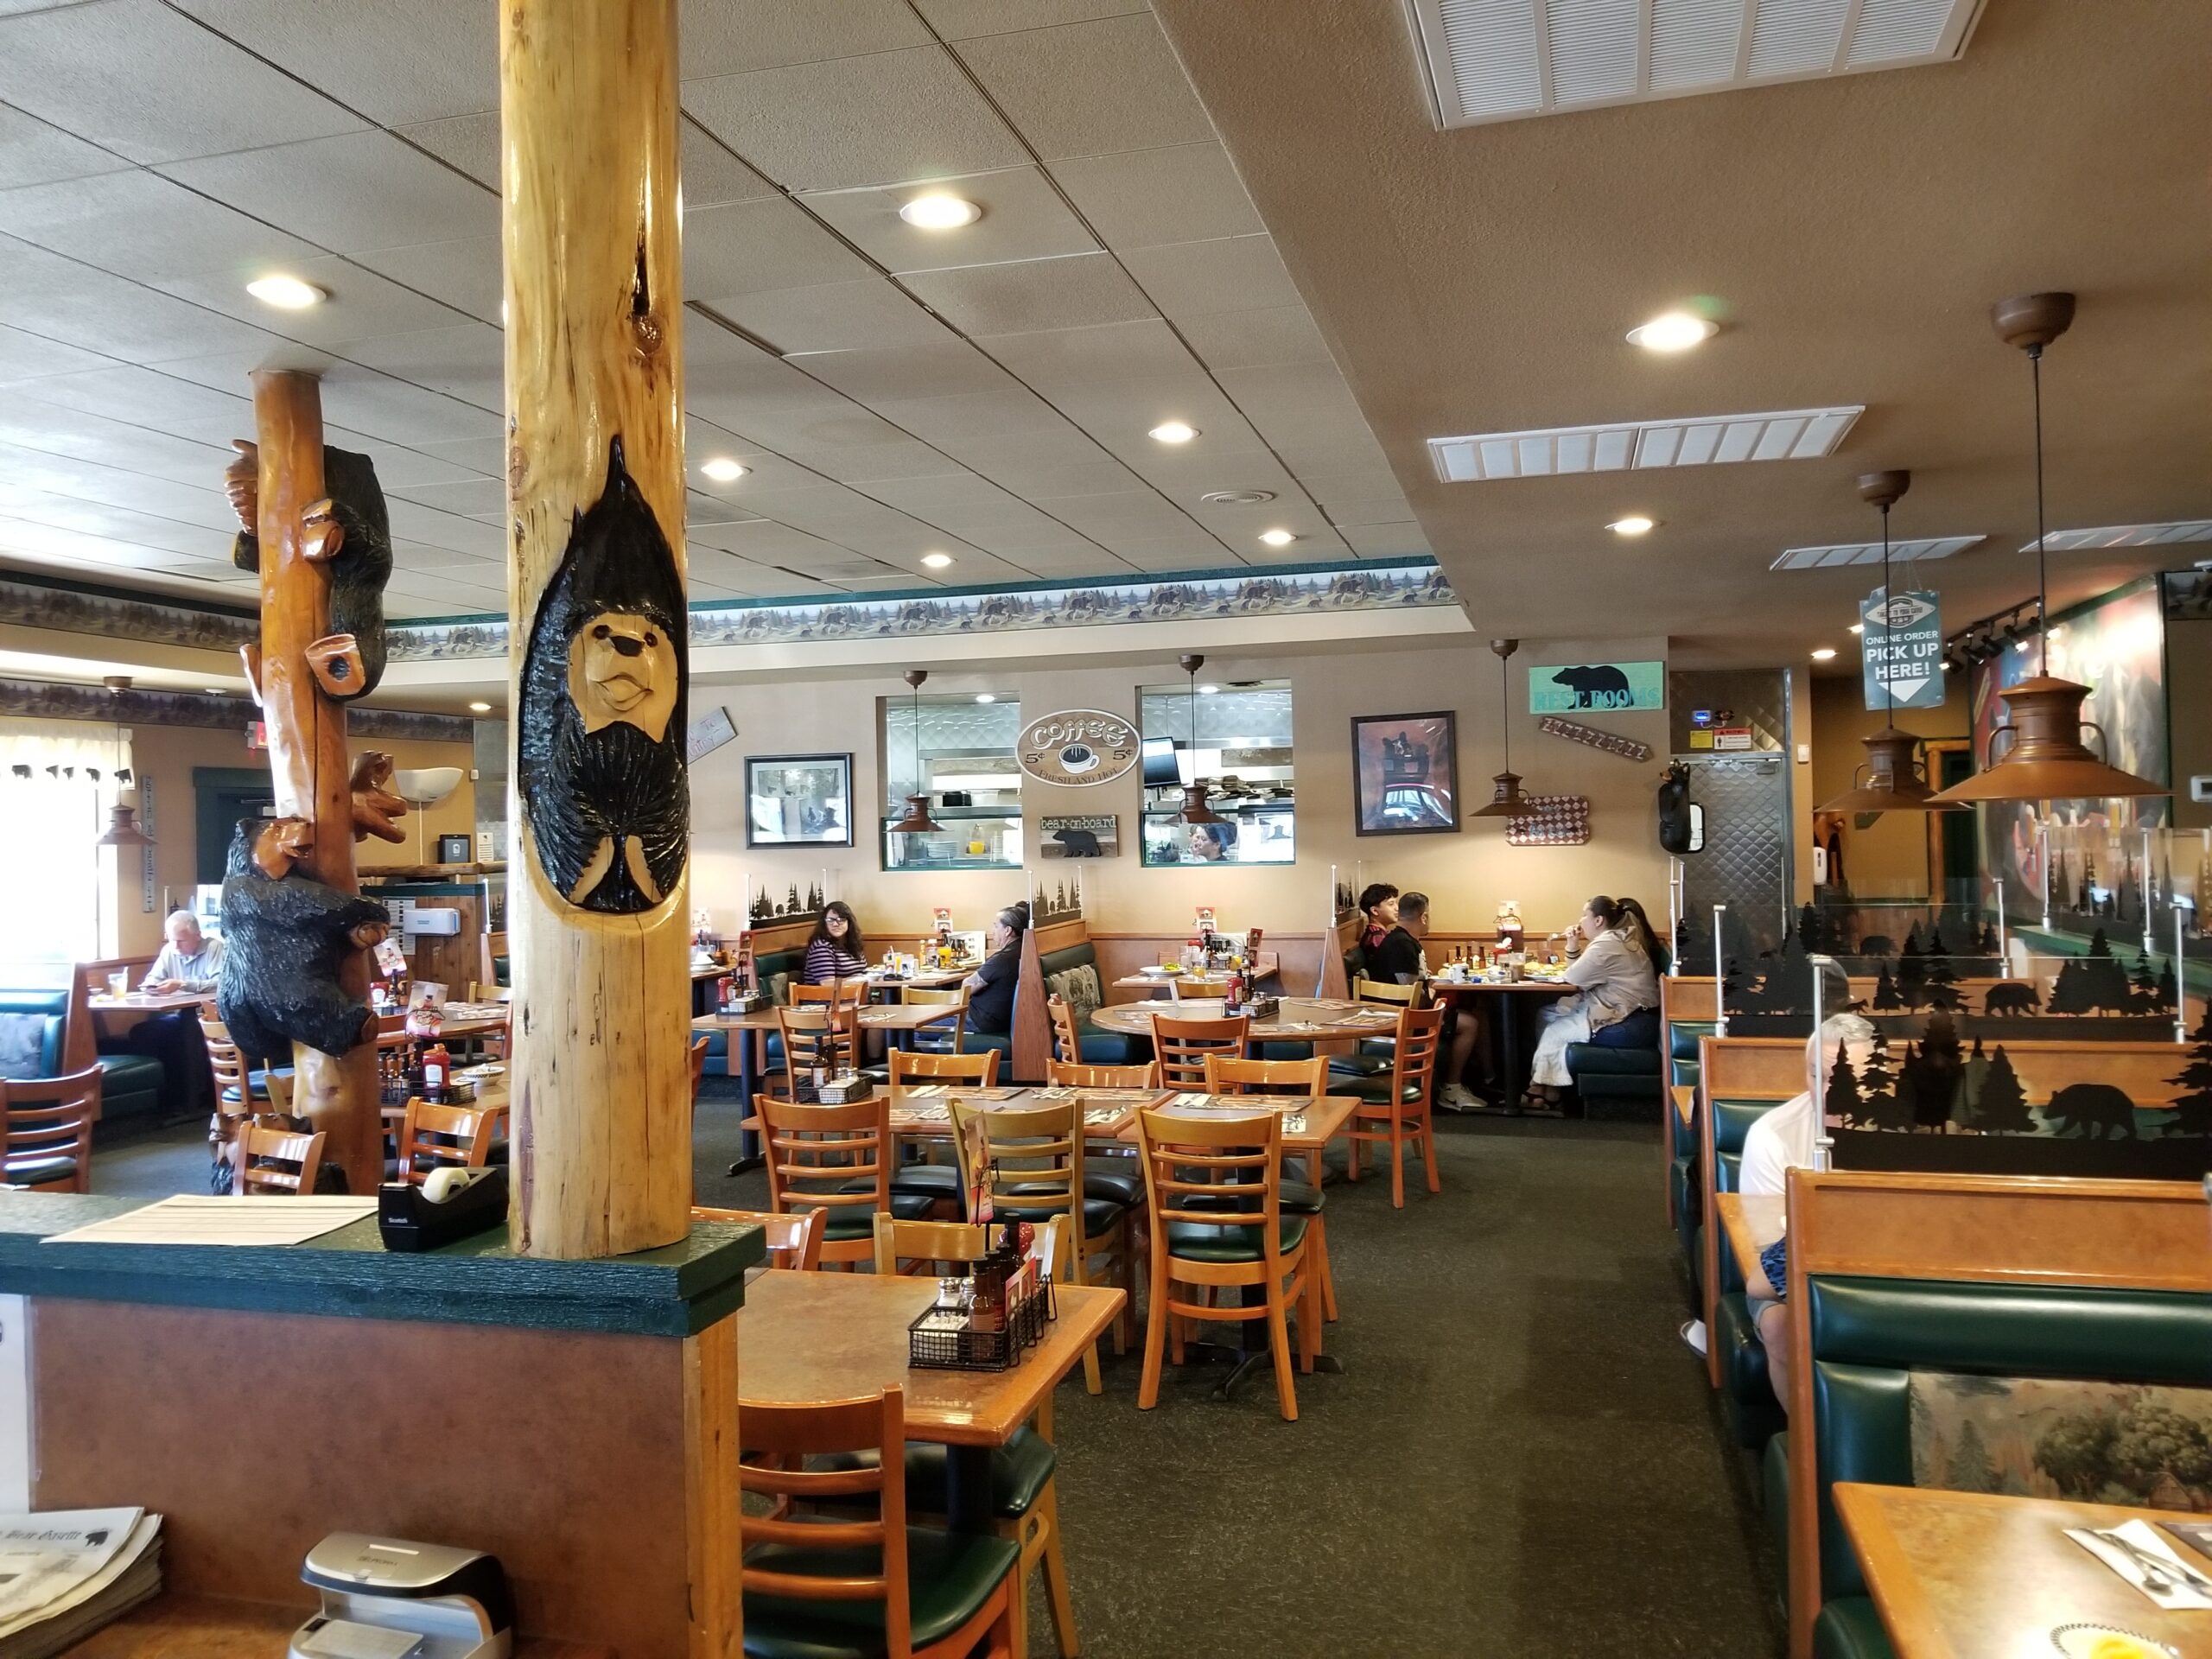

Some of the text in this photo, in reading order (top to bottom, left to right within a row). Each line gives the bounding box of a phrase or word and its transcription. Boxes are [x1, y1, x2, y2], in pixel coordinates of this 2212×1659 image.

[1866, 631, 1939, 645] ONLINE ORDER
[1866, 643, 1939, 663] PICK UP
[1875, 662, 1930, 680] HERE!
